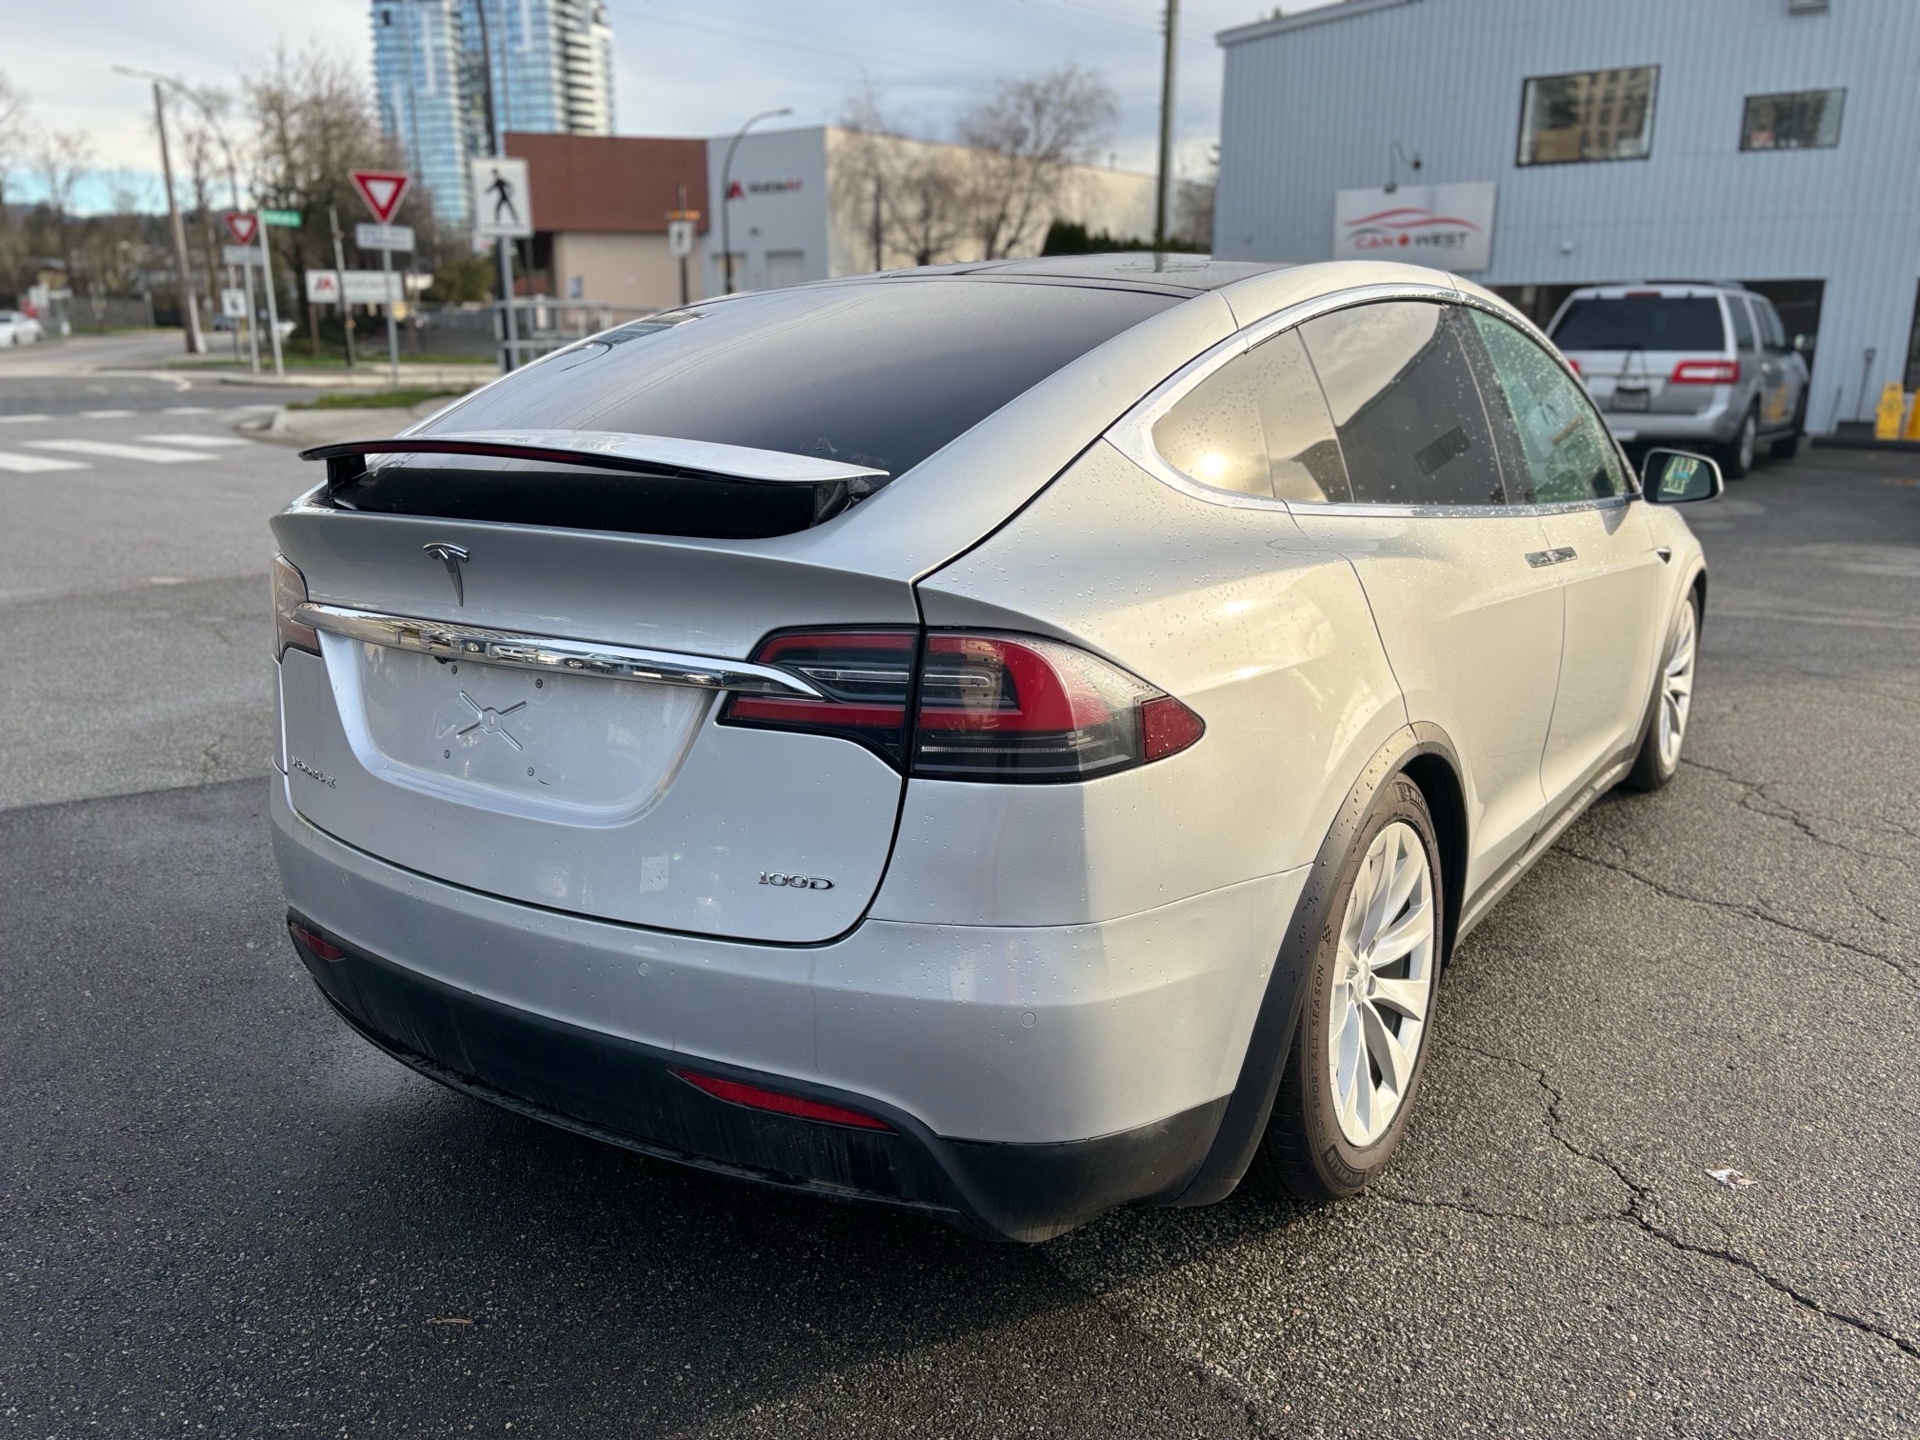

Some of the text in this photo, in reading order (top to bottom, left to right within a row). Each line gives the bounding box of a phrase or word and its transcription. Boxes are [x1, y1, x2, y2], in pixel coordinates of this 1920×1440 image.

[1355, 231, 1468, 249] CAN WEST
[758, 870, 835, 890] 100D
[1312, 966, 1325, 1028] SEASON
[1311, 1068, 1321, 1109] SPORT
[1315, 1116, 1327, 1143] PILOT
[1326, 1148, 1365, 1187] MICHELIN
